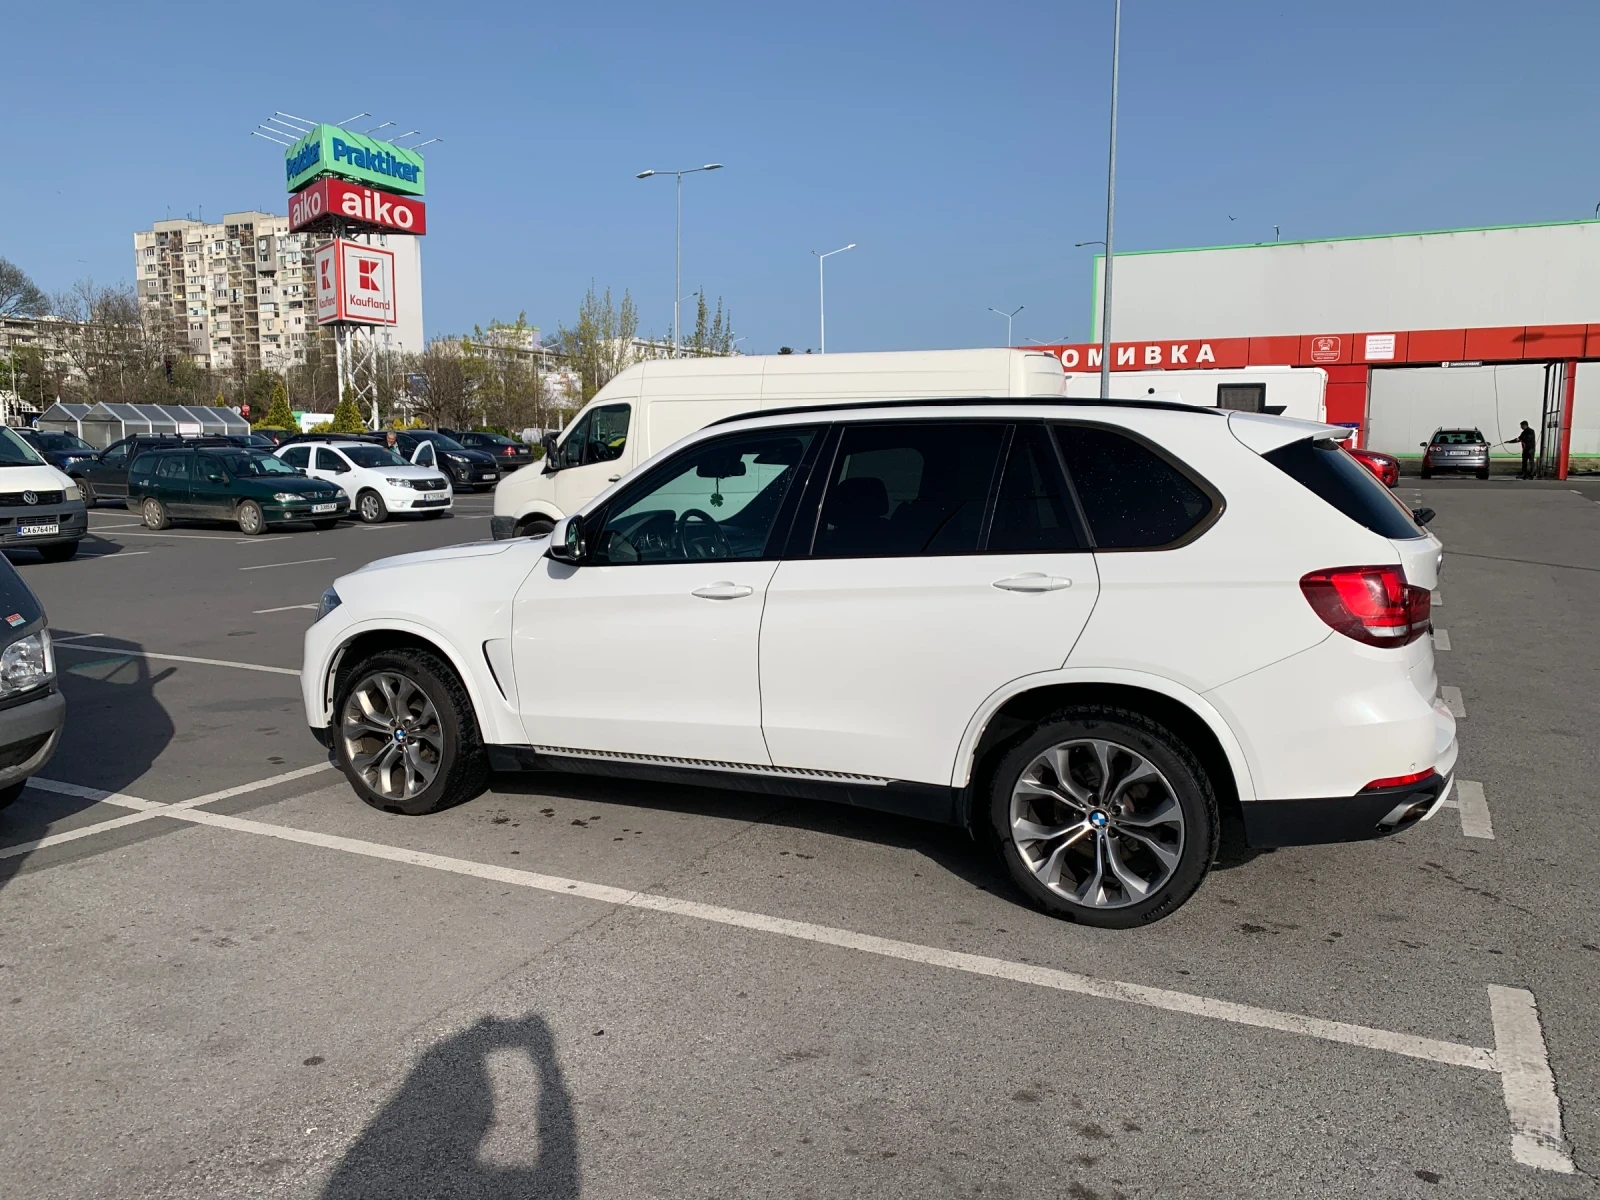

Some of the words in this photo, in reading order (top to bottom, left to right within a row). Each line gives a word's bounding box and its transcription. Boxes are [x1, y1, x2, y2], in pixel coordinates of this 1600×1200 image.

[332, 137, 420, 183] Praktiker
[293, 192, 321, 227] aiko
[341, 189, 413, 228] aiko
[350, 294, 390, 310] Kaufland
